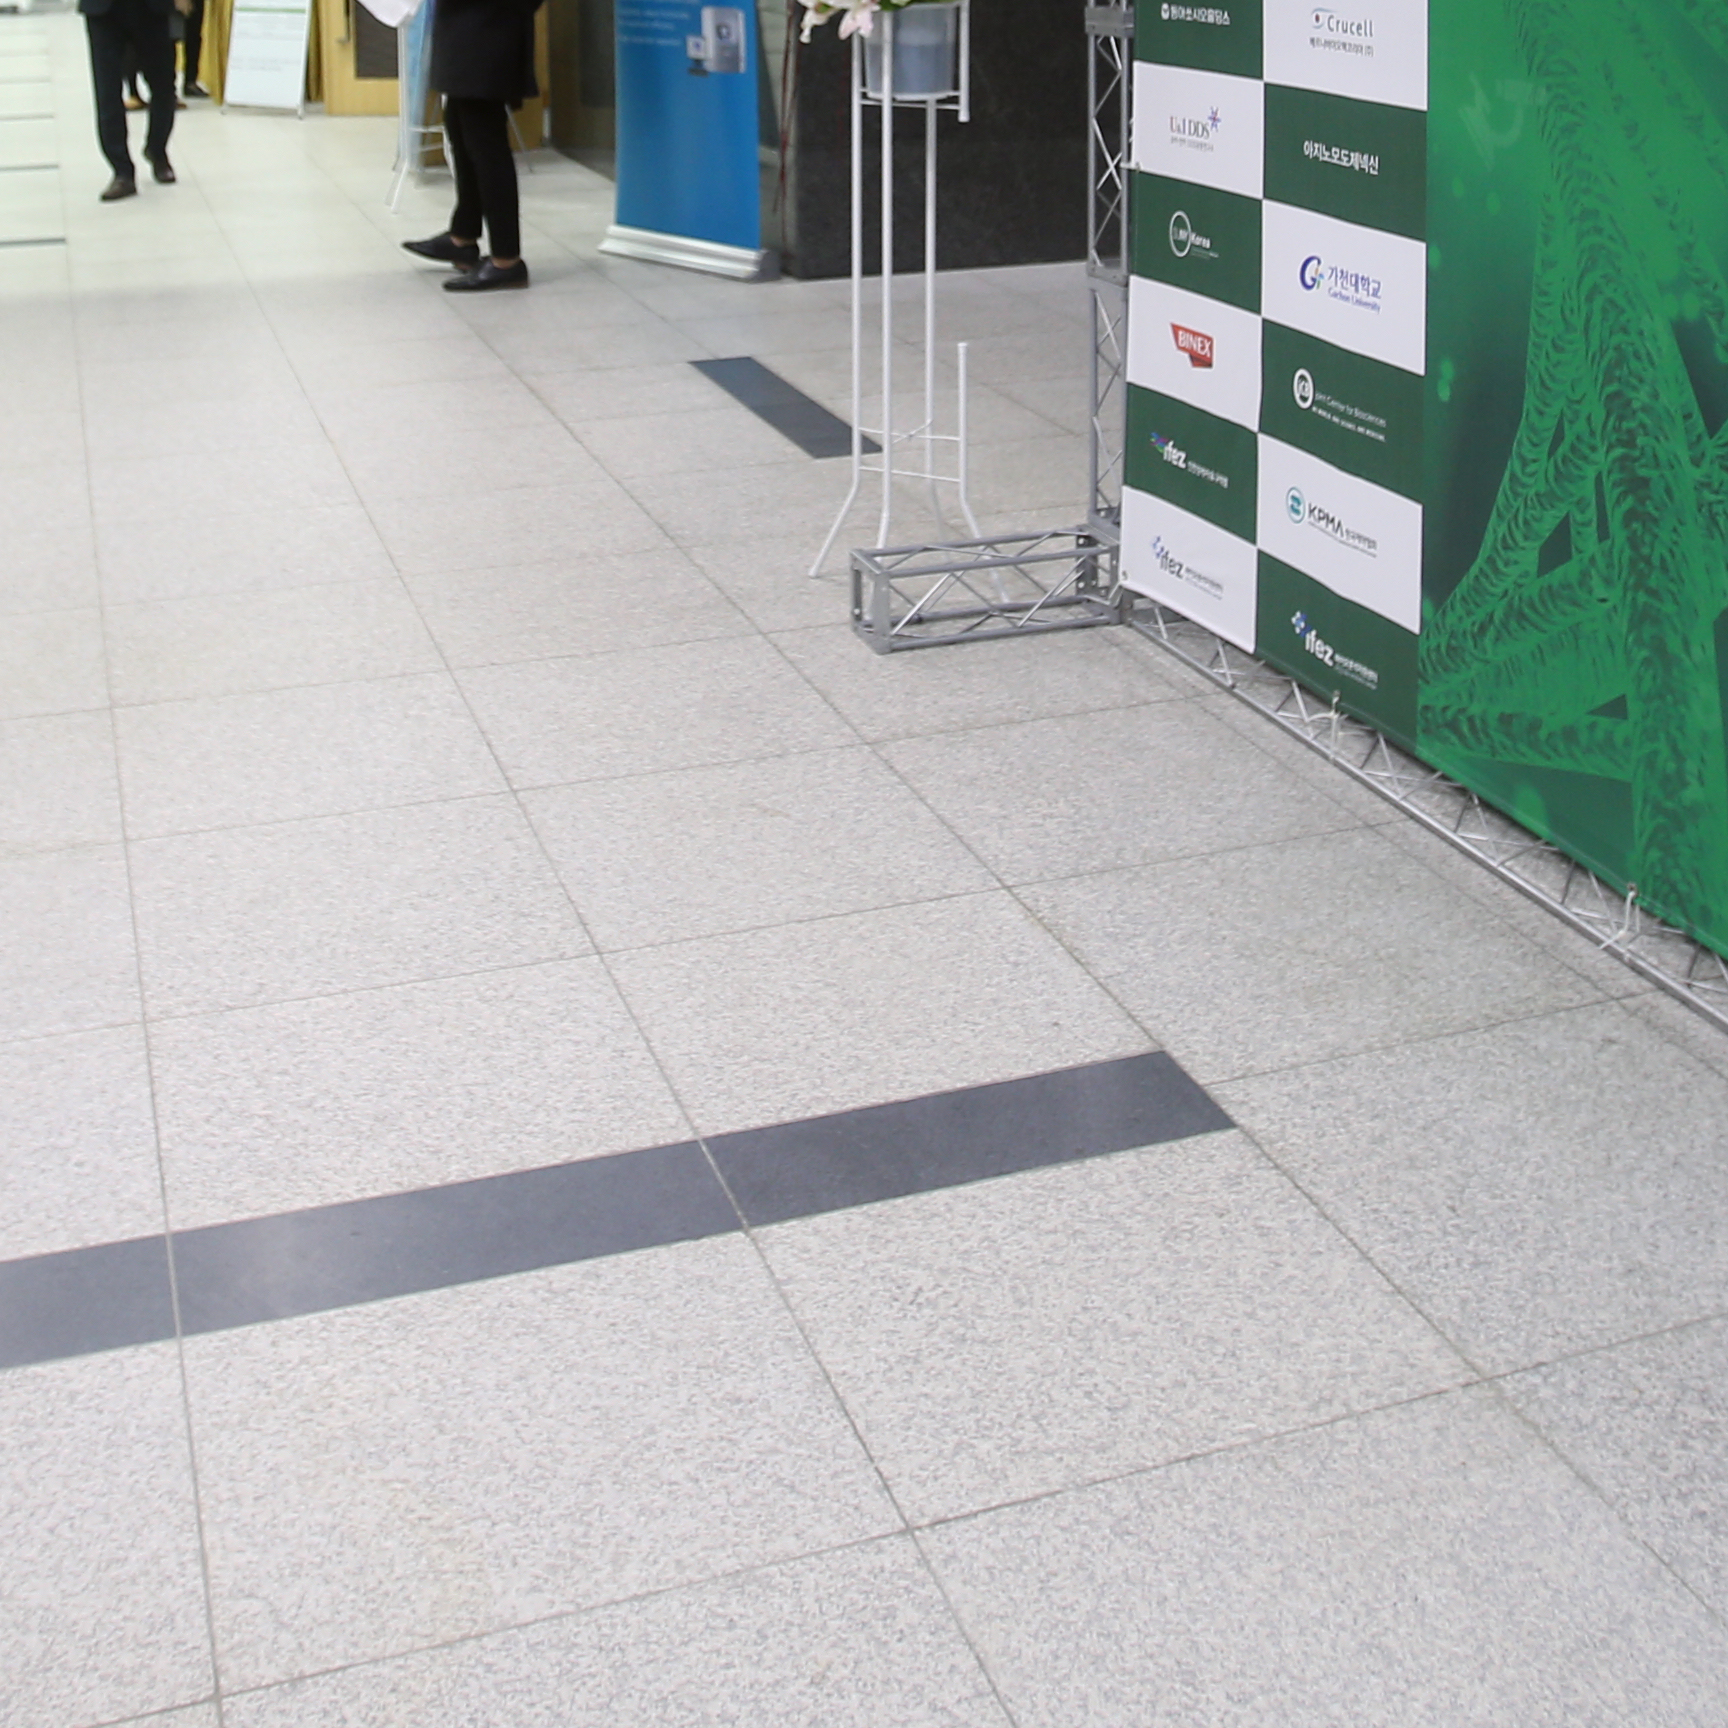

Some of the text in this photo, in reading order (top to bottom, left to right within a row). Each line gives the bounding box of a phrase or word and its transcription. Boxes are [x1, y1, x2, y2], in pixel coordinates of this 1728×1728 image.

[1327, 15, 1373, 37] Crucell
[1303, 140, 1379, 175] 아지노모도제넥신
[1327, 266, 1382, 299] 가천대학교
[1178, 330, 1212, 358] BINEX
[1308, 503, 1345, 535] KPMA
